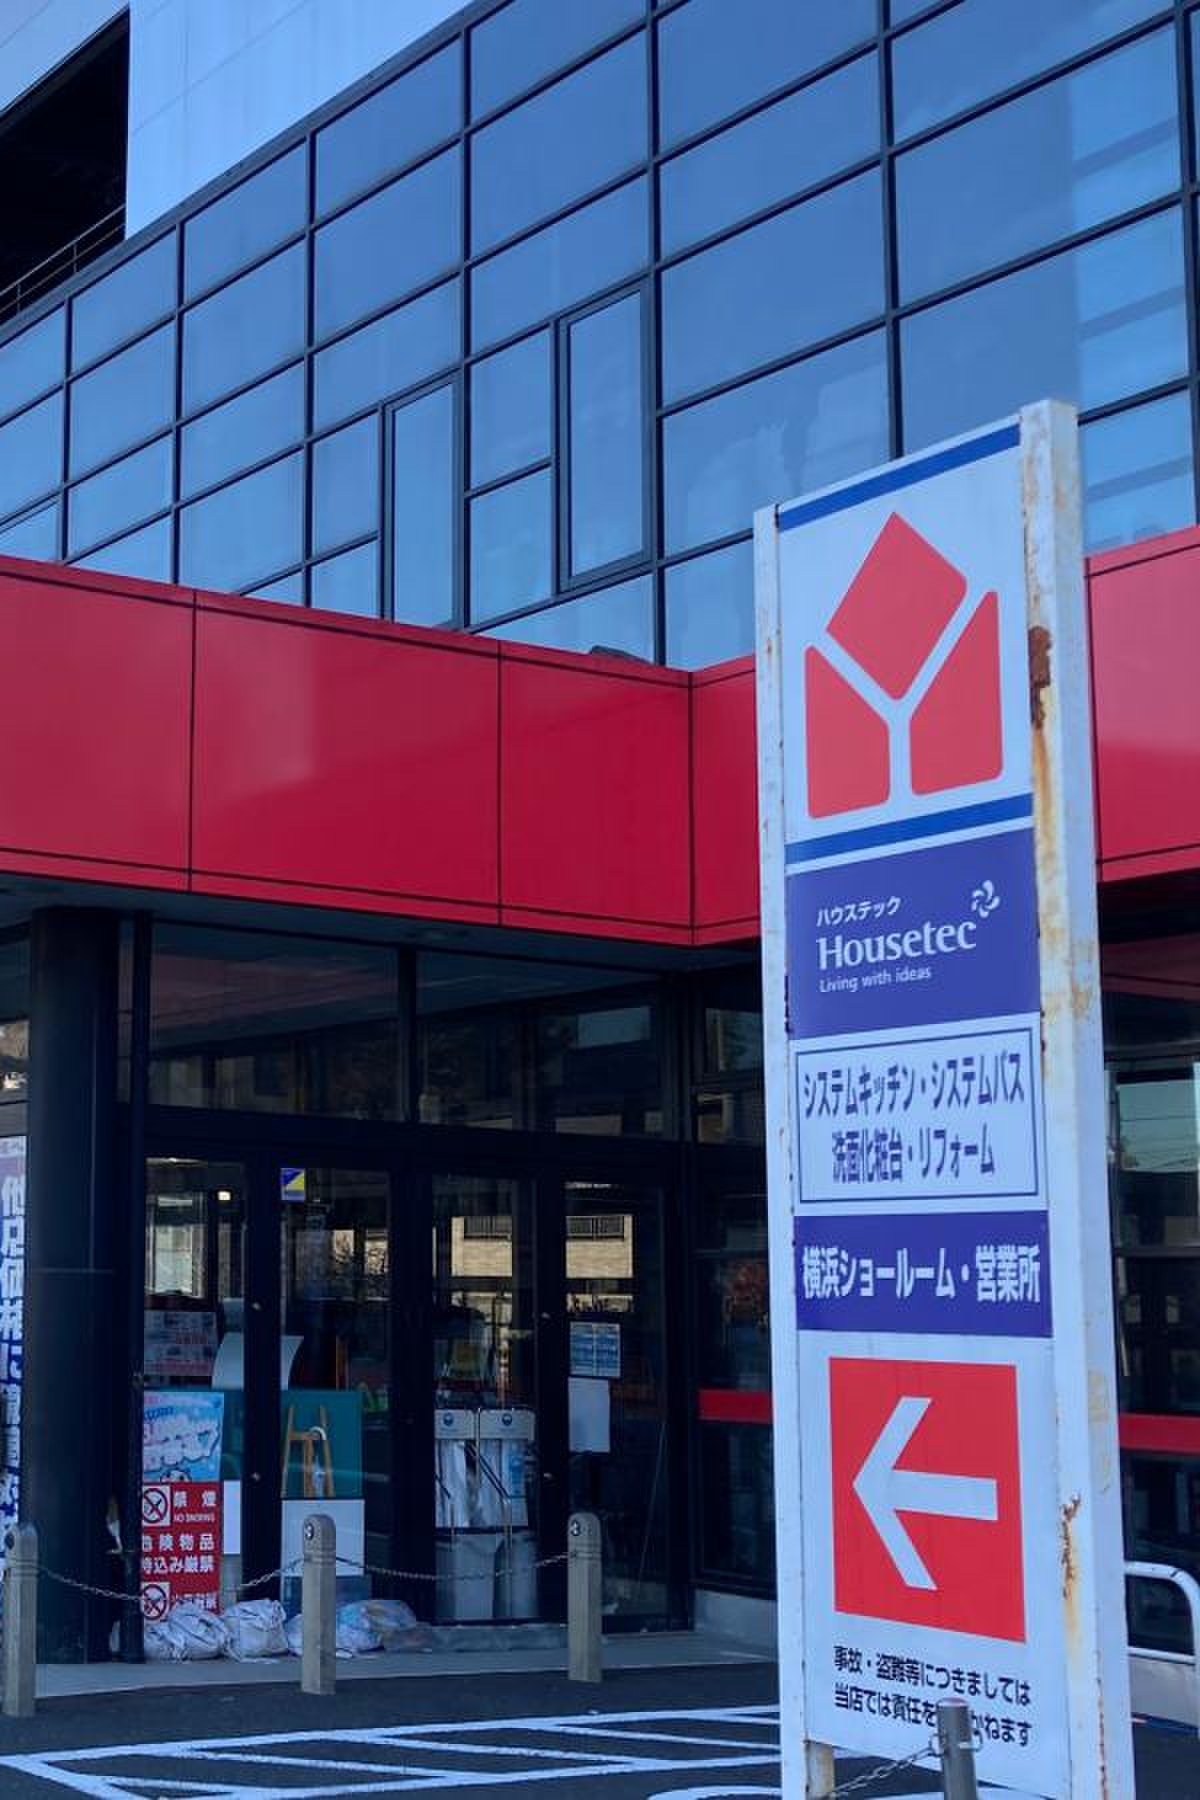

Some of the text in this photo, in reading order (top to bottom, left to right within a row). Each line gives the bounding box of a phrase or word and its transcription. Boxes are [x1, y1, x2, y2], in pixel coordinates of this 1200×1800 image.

[816, 896, 901, 927] ハウステック
[816, 921, 977, 970] Housetec
[819, 965, 932, 993] Living with ideas
[804, 1050, 1025, 1119] システムキッチン・システムバス
[832, 1123, 996, 1184] 洗面化粧台・リフォーム
[802, 1244, 1041, 1303] 横浜ショールーム・営業所
[833, 1645, 1031, 1706] 事故・盗難等につきましては
[834, 1681, 1032, 1747] 当店では責任をかねます
